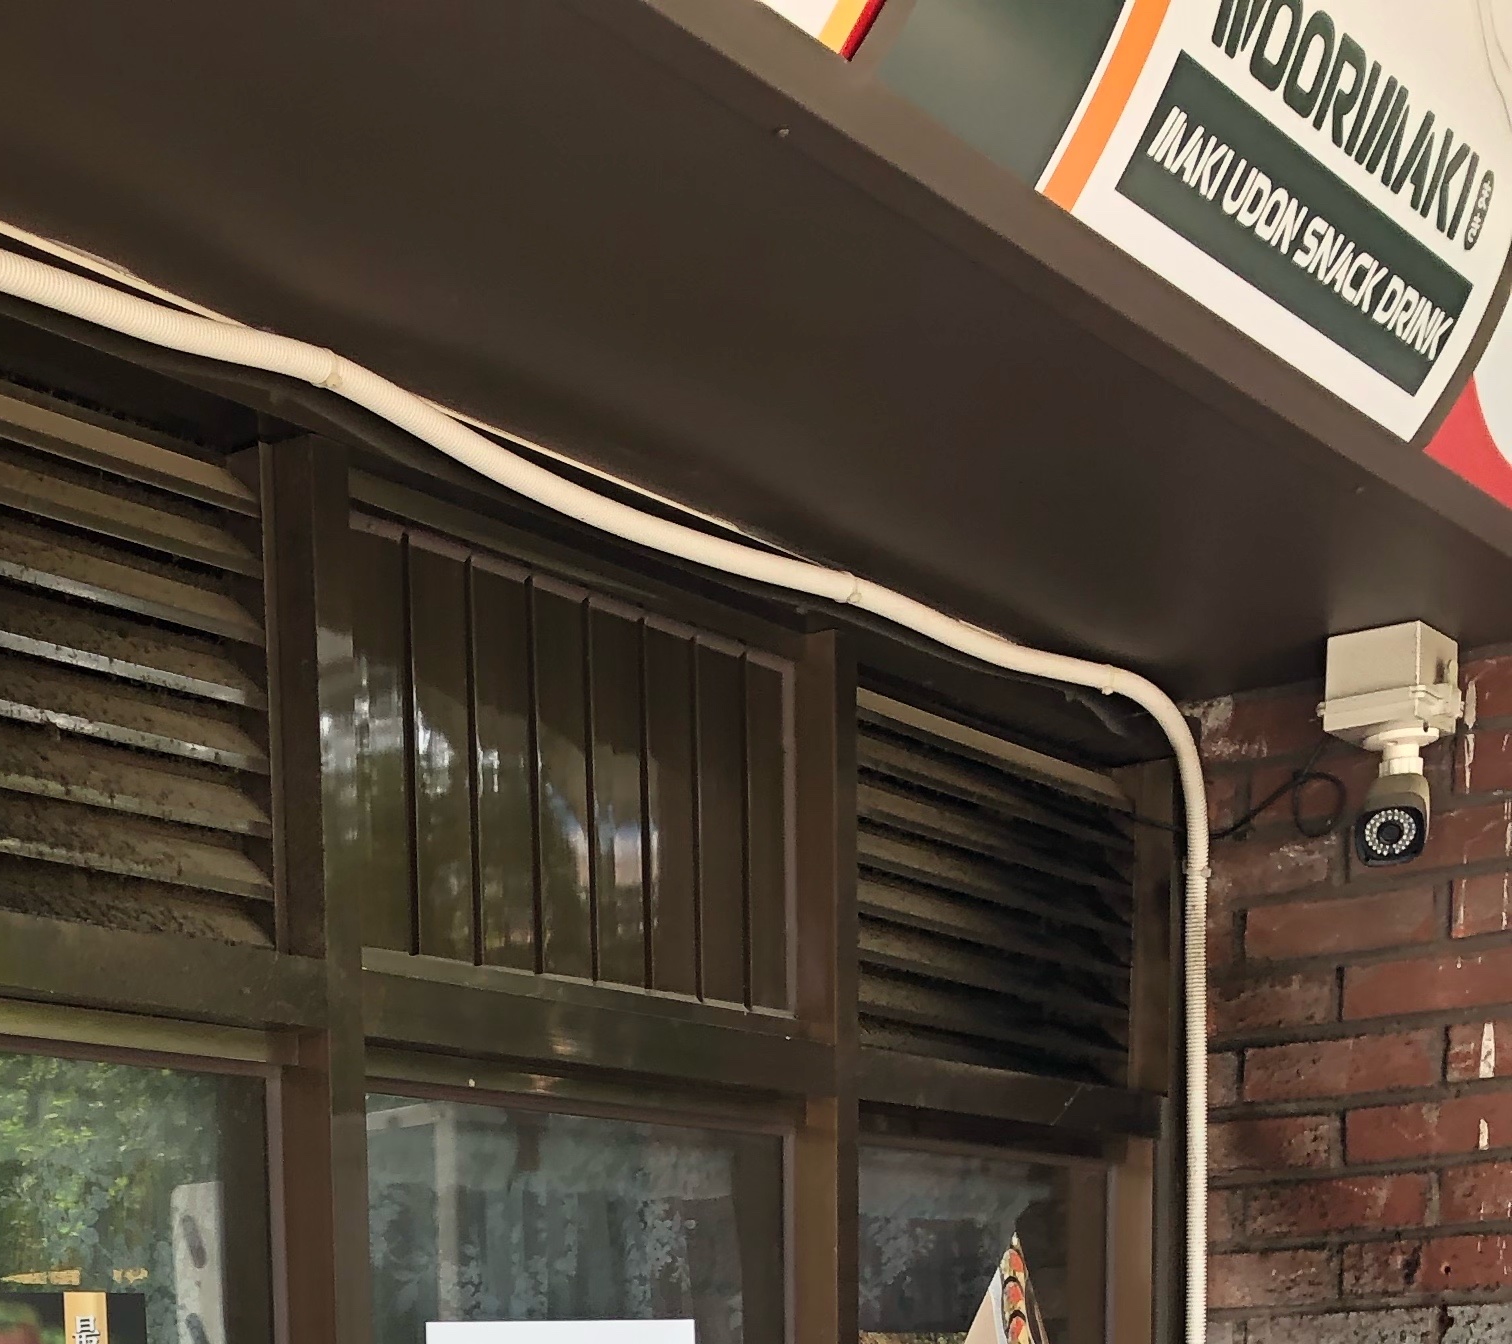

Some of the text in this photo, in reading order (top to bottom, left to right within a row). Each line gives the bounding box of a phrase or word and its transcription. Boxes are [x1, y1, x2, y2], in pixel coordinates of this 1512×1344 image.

[1147, 105, 1454, 361] MAKI UDON SNACK DRINK
